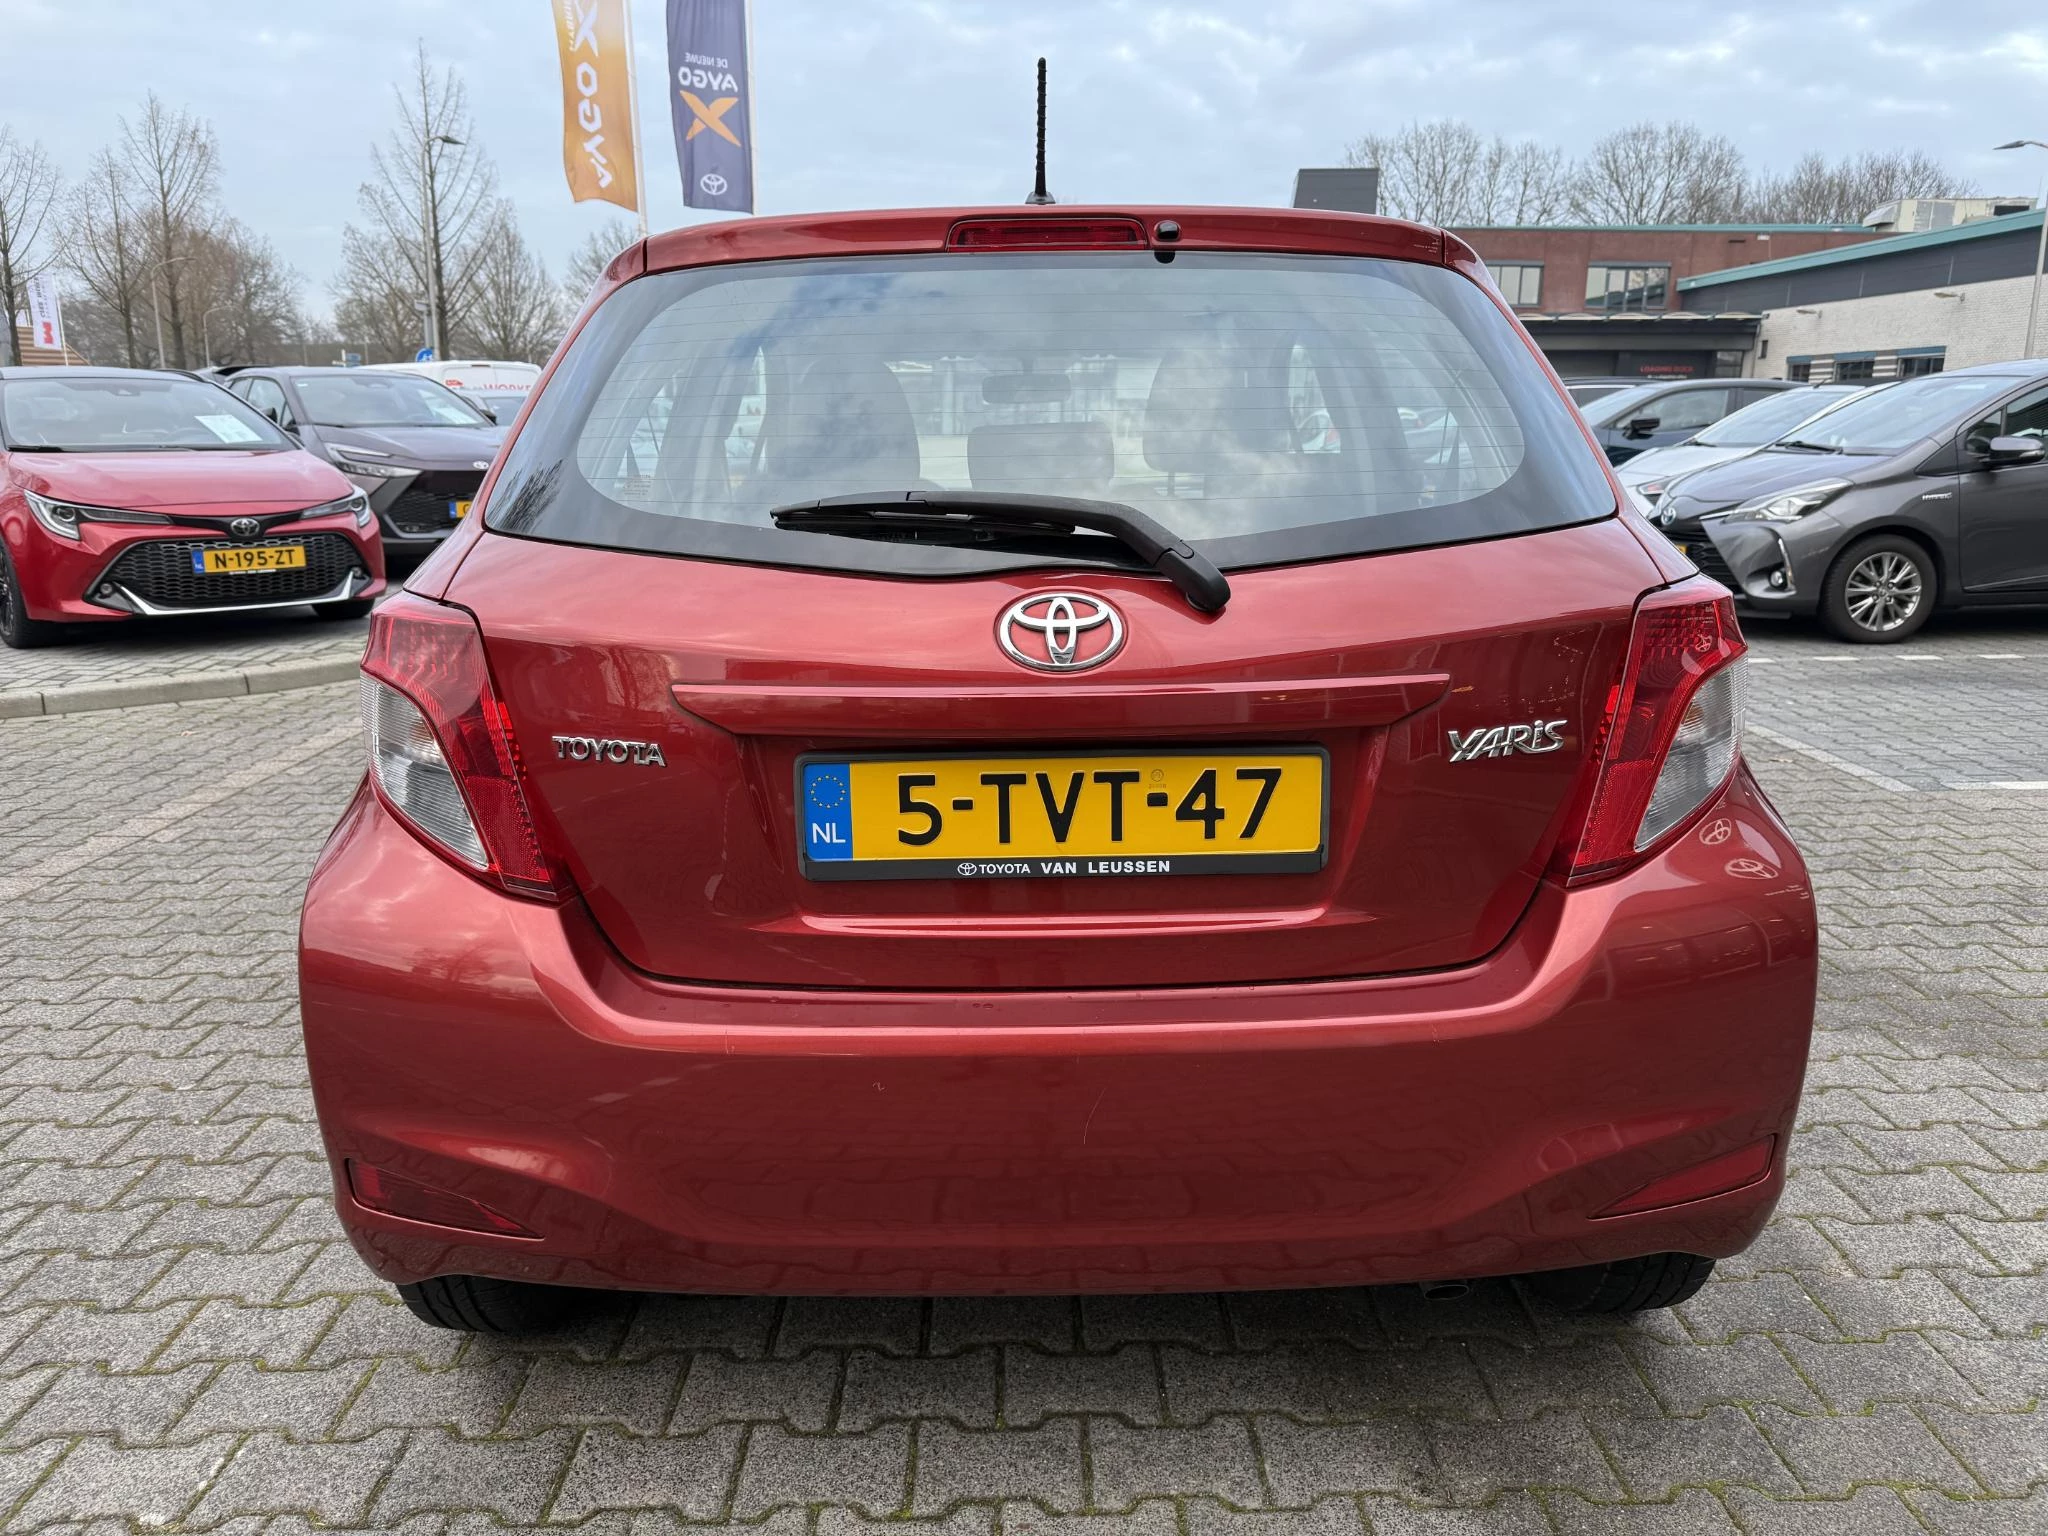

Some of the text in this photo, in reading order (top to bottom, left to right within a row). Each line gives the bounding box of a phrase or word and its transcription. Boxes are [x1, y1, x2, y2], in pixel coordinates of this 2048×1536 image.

[214, 549, 296, 569] N-195-ZT
[552, 735, 667, 767] TOYOTA
[897, 767, 1283, 847] 5-TVT-47
[811, 822, 847, 845] NL
[978, 860, 1170, 875] TOYOTA VAN LEUSSEN
